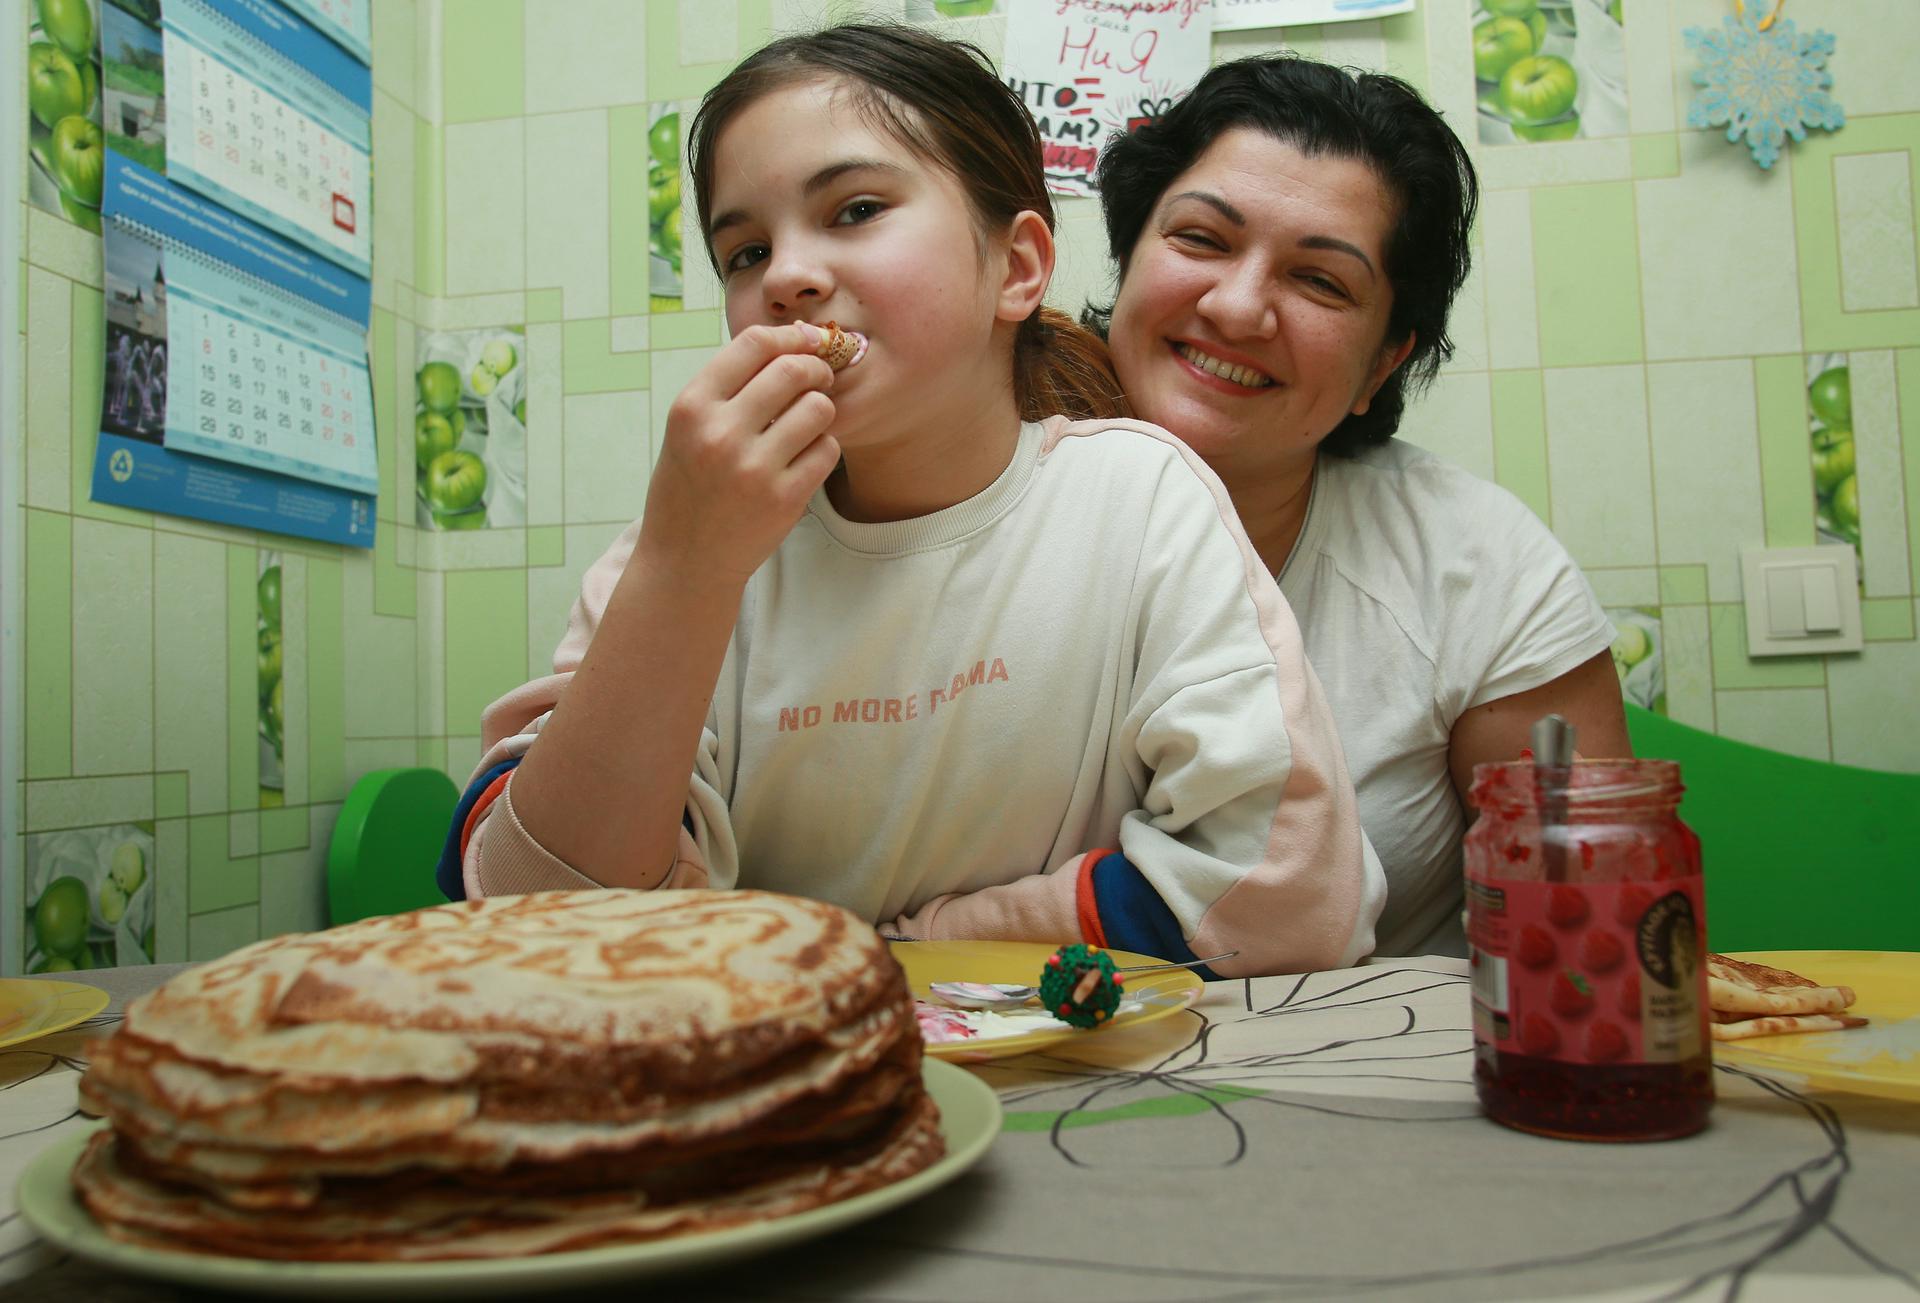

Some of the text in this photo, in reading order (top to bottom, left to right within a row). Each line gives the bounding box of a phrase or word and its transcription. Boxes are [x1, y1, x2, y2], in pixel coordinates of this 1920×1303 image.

[203, 314, 209, 328] 1
[228, 323, 236, 338] 2
[276, 343, 283, 354] 4
[202, 364, 216, 381] 15
[228, 373, 241, 389] 16
[254, 381, 266, 396] 17
[277, 390, 289, 405] 18
[300, 397, 312, 412] 19
[229, 348, 238, 363] 9
[252, 357, 265, 373] 10
[276, 365, 287, 378] 11
[299, 374, 311, 389] 12
[201, 390, 216, 408] 22
[227, 398, 242, 415] 23
[254, 406, 268, 421] 24
[278, 413, 291, 429] 25
[300, 420, 313, 436] 26
[201, 416, 267, 445] 29 30 31
[778, 706, 822, 732] NO
[832, 694, 918, 723] MORE
